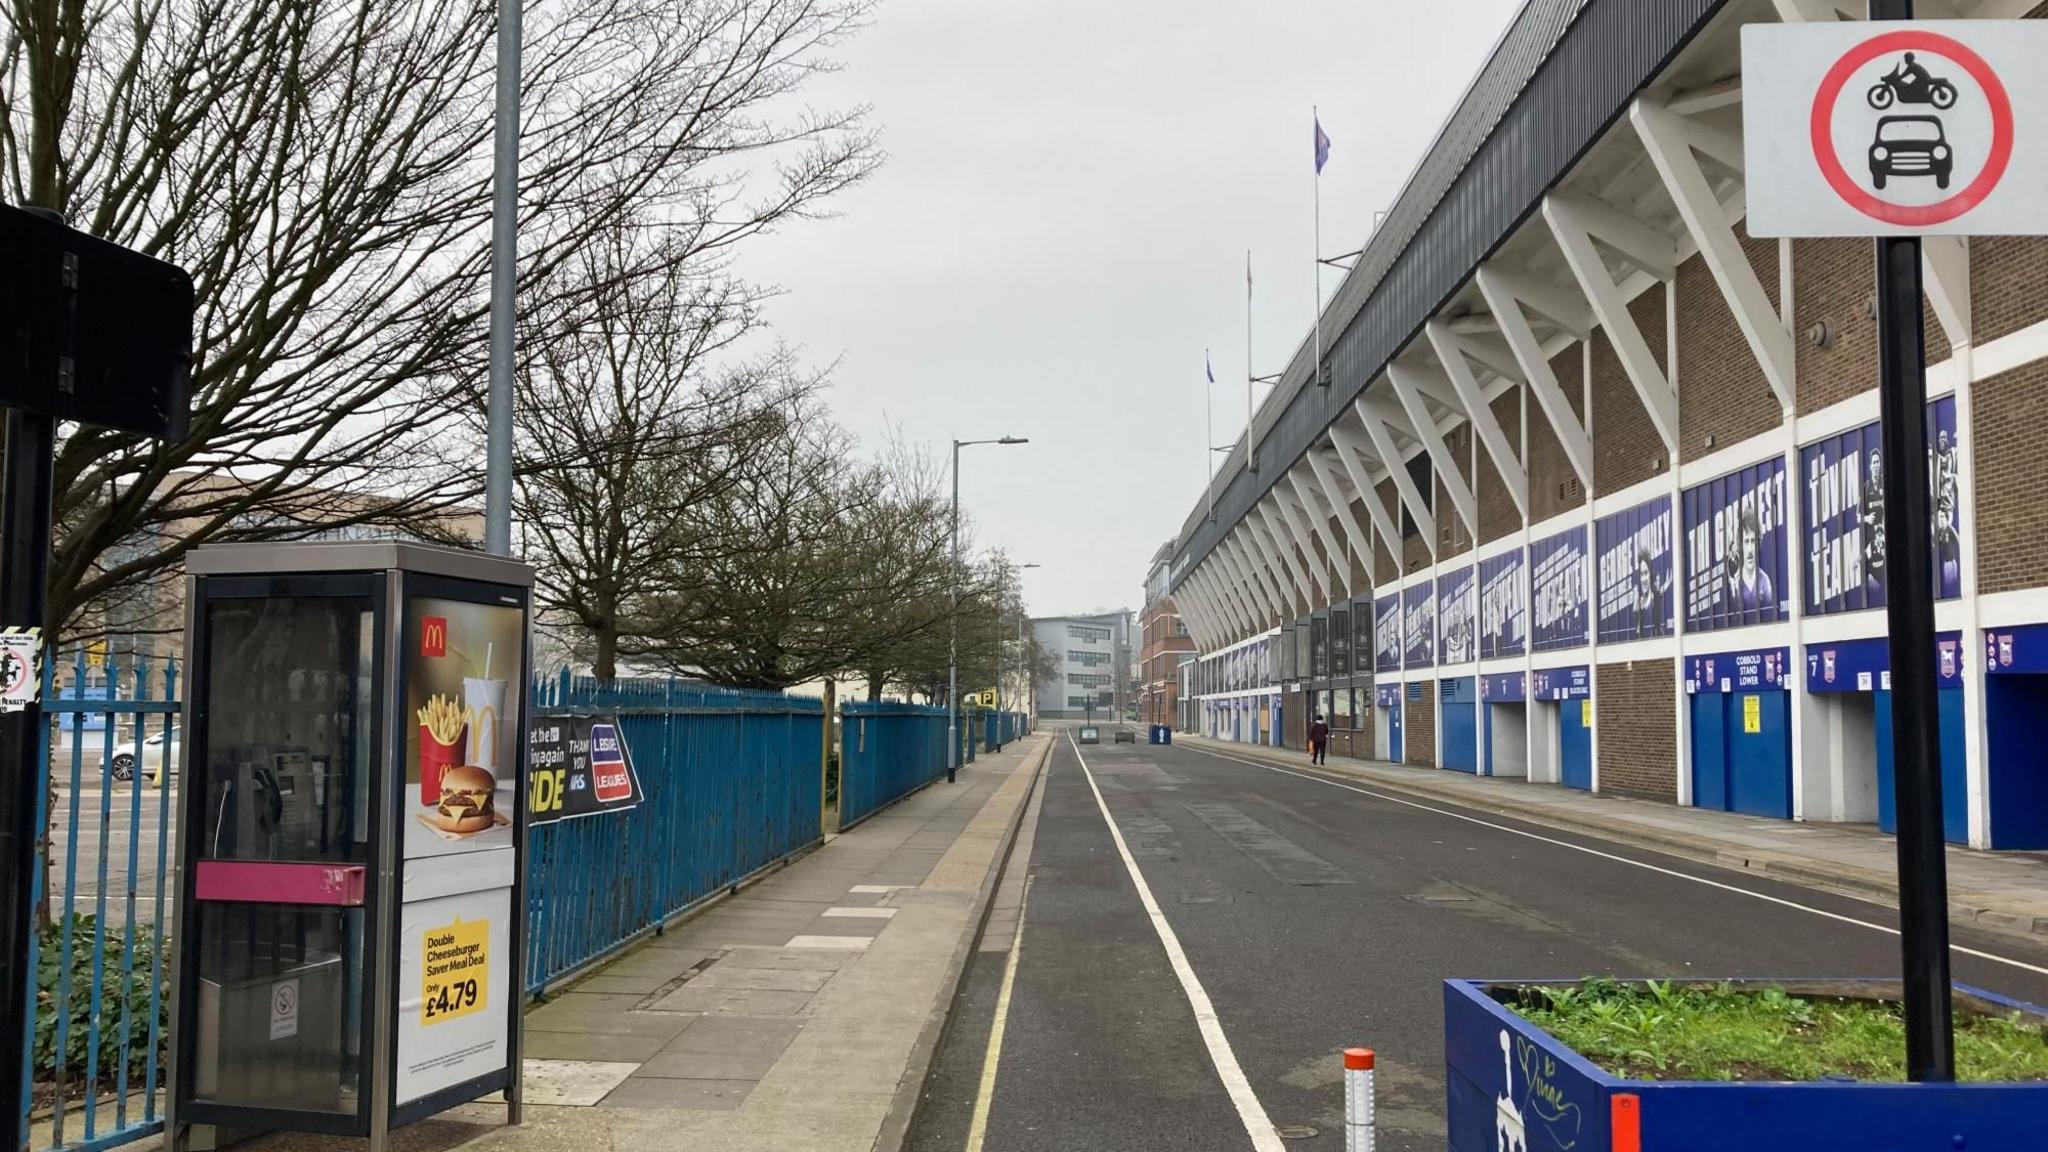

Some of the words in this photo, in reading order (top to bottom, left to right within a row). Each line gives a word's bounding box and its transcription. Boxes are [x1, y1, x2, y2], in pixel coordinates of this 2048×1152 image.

[1811, 528, 1862, 606] TEAM
[1736, 654, 1761, 666] COBBOLD
[1740, 665, 1758, 676] STAND
[1739, 676, 1759, 686] LOWER
[983, 693, 992, 704] P
[540, 746, 565, 767] again
[573, 756, 587, 770] YOU
[569, 773, 586, 791] NHS
[427, 934, 455, 949] Double
[427, 943, 480, 963] Cheeseburger
[426, 964, 449, 977] Saver
[449, 959, 468, 972] Meal
[468, 953, 485, 968] Deal
[426, 983, 440, 994] Only
[425, 978, 477, 1018] £4.79
